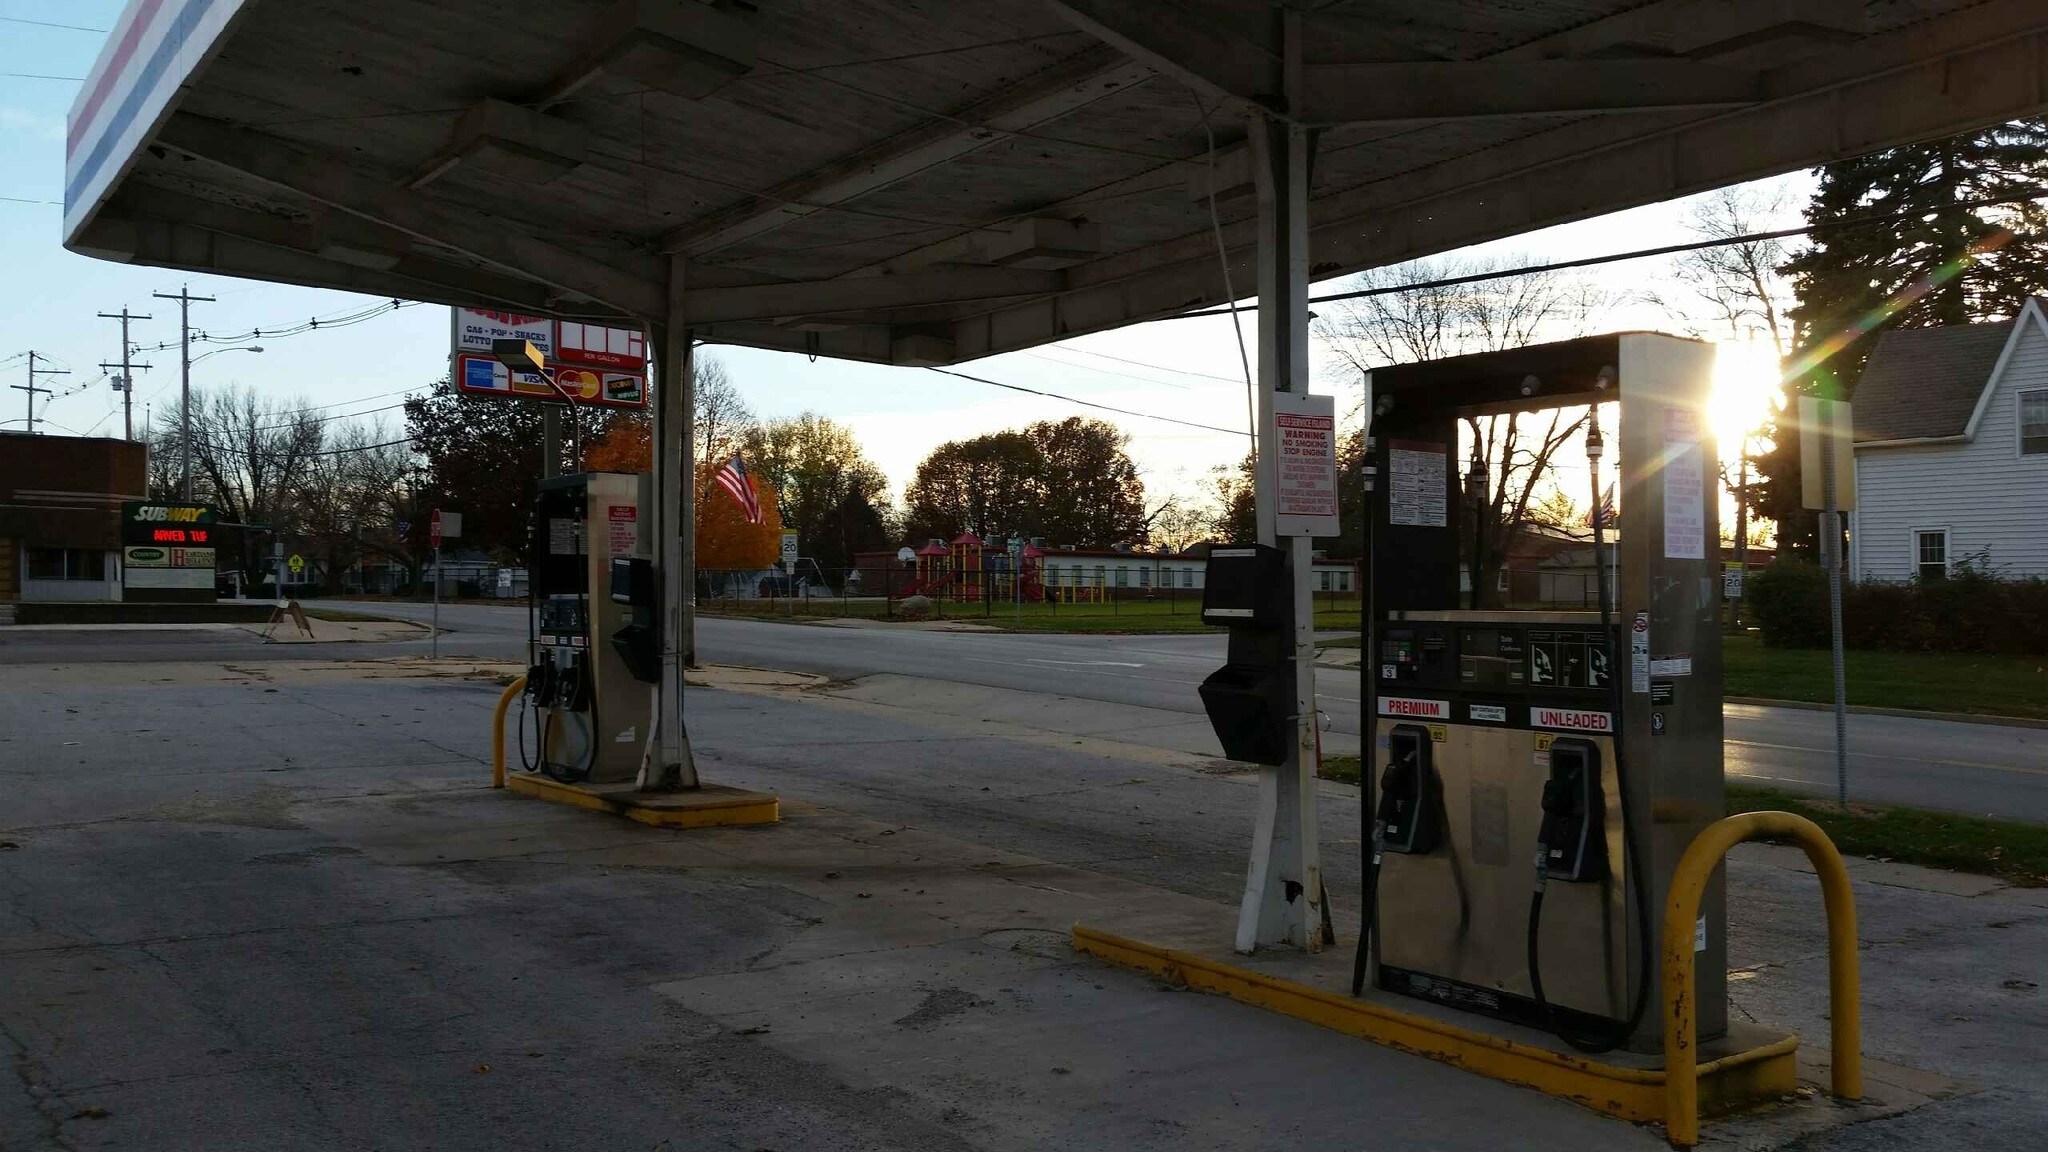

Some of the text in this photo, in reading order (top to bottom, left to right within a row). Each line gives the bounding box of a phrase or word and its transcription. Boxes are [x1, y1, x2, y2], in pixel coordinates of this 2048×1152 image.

[491, 329, 507, 337] POP
[515, 330, 546, 341] SNACKS
[463, 335, 491, 345] LOTTO
[524, 375, 544, 383] VISA
[1285, 430, 1326, 439] WARNING
[1296, 440, 1328, 448] SMOKING
[133, 506, 207, 522] SUBWAY
[784, 543, 796, 552] 20
[1727, 579, 1740, 587] 20
[1389, 700, 1440, 716] PREMIUM
[1540, 711, 1608, 729] UNLEADED
[1538, 740, 1548, 749] 87
